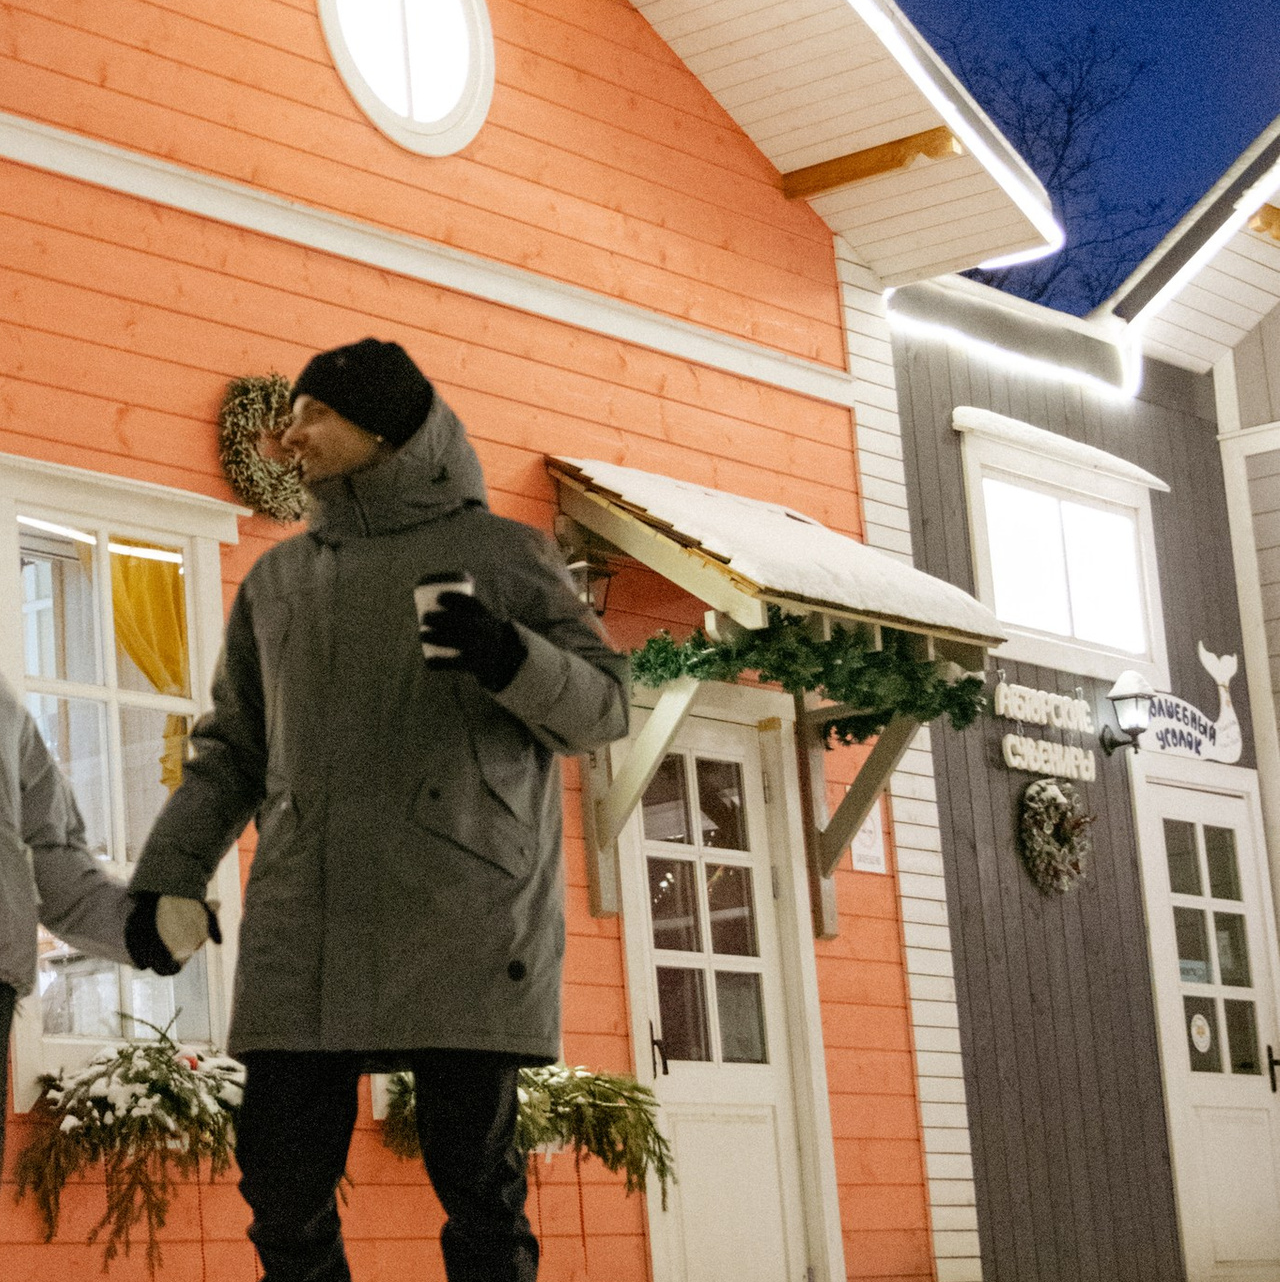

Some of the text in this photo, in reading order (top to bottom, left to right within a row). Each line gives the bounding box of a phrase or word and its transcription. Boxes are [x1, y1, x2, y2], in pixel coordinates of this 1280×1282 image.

[995, 682, 1095, 733] АВТОРСКИЕ
[1148, 698, 1217, 746] ОЛШЕБНЫЙ
[1002, 731, 1096, 781] СУВЕНИРЫ
[1155, 727, 1202, 756] УГОЛОК
